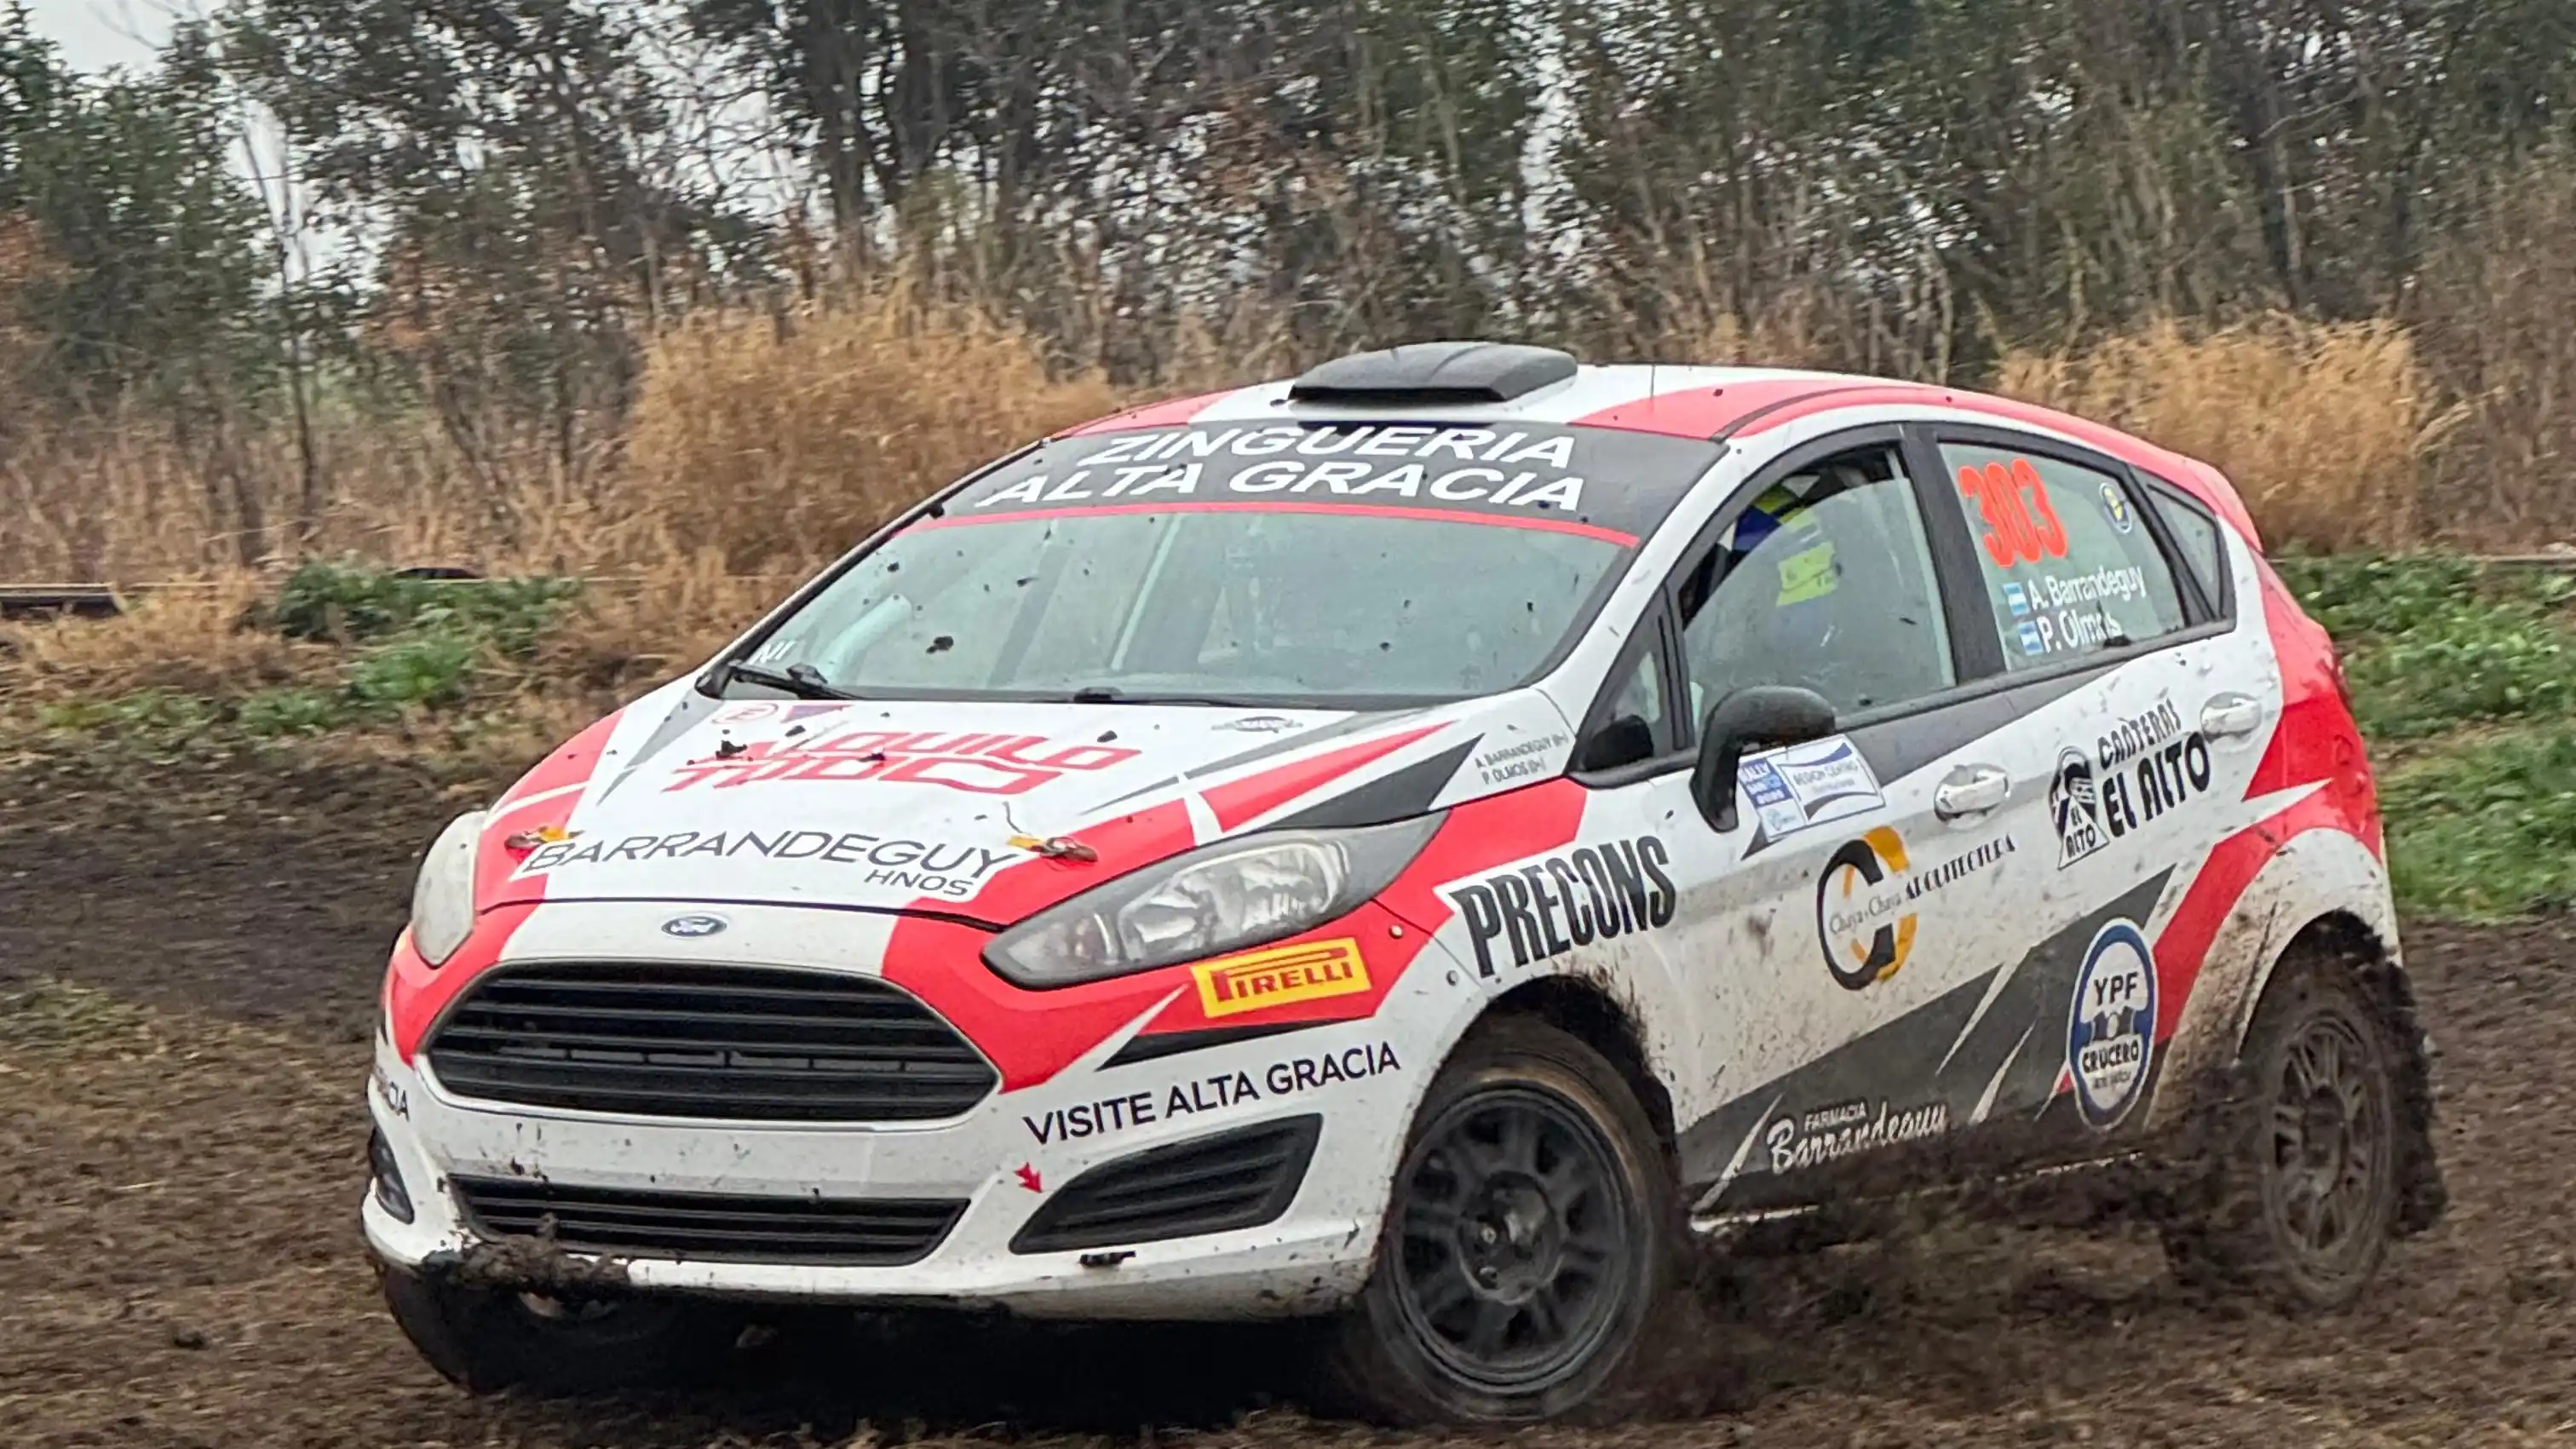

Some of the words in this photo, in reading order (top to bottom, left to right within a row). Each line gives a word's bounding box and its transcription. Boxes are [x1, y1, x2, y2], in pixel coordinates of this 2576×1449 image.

[1078, 426, 1576, 468] ZINGUERIA
[975, 463, 1201, 508] ALTA
[1228, 461, 1584, 511] GRACIA
[1958, 457, 2067, 568] 303
[2027, 579, 2049, 611] A.
[2047, 566, 2147, 606] Barrandeguy
[2036, 617, 2062, 653] P.
[2098, 698, 2181, 769] CANTERAS
[2102, 772, 2137, 837] EL
[2137, 732, 2211, 821] ALTO
[522, 830, 1025, 879] BARRANDEGUY
[863, 870, 980, 896] HNOS
[1448, 836, 1676, 978] PRECONS
[1210, 947, 1354, 1003] PIRELLI
[2094, 971, 2138, 1005] YPF
[2082, 1039, 2139, 1073] CRUCERO
[1022, 1091, 1157, 1144] VISITE
[1165, 1071, 1262, 1118] ALTA
[1266, 1042, 1401, 1095] GRACIA
